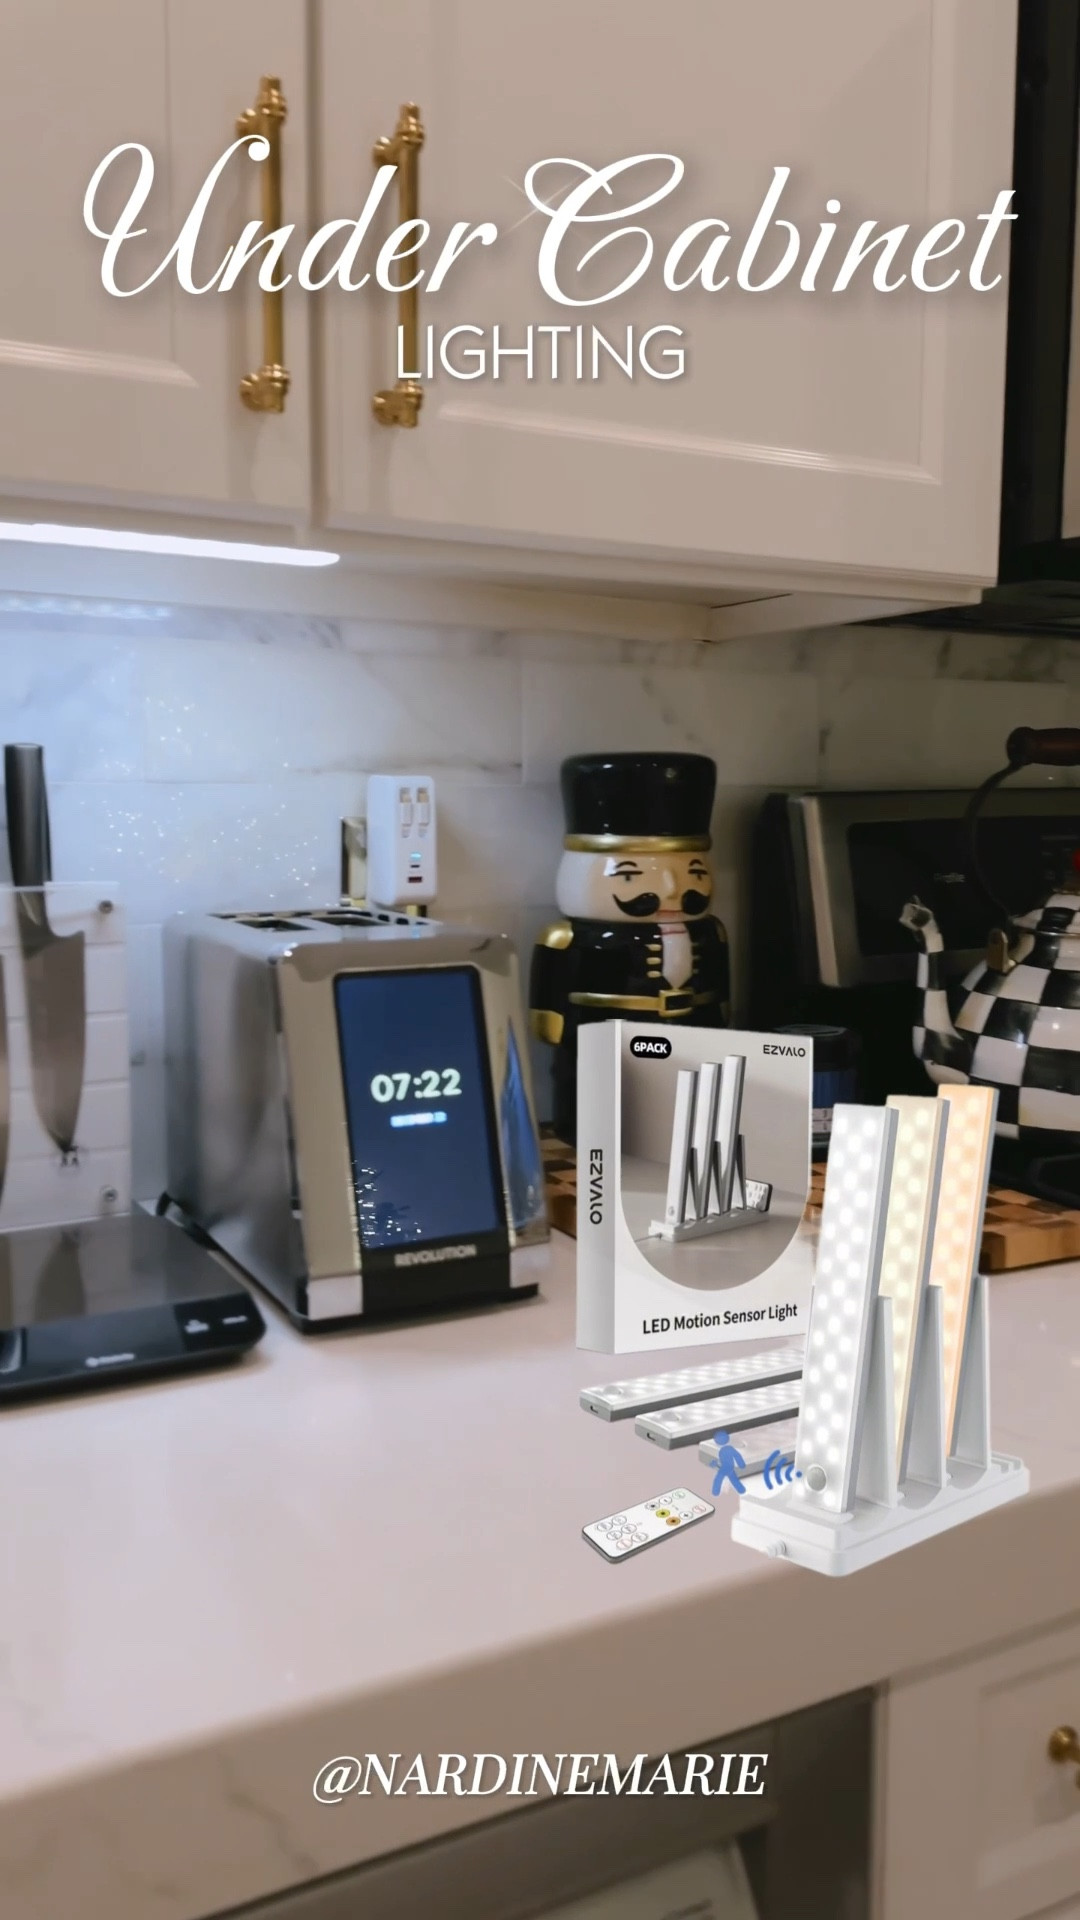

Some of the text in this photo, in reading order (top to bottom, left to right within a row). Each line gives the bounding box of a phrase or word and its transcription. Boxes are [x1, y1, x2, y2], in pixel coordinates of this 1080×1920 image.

[633, 1041, 668, 1054] 6PACK
[370, 1068, 462, 1103] 07:22
[642, 1303, 798, 1335] LED Motion Sensor Light
